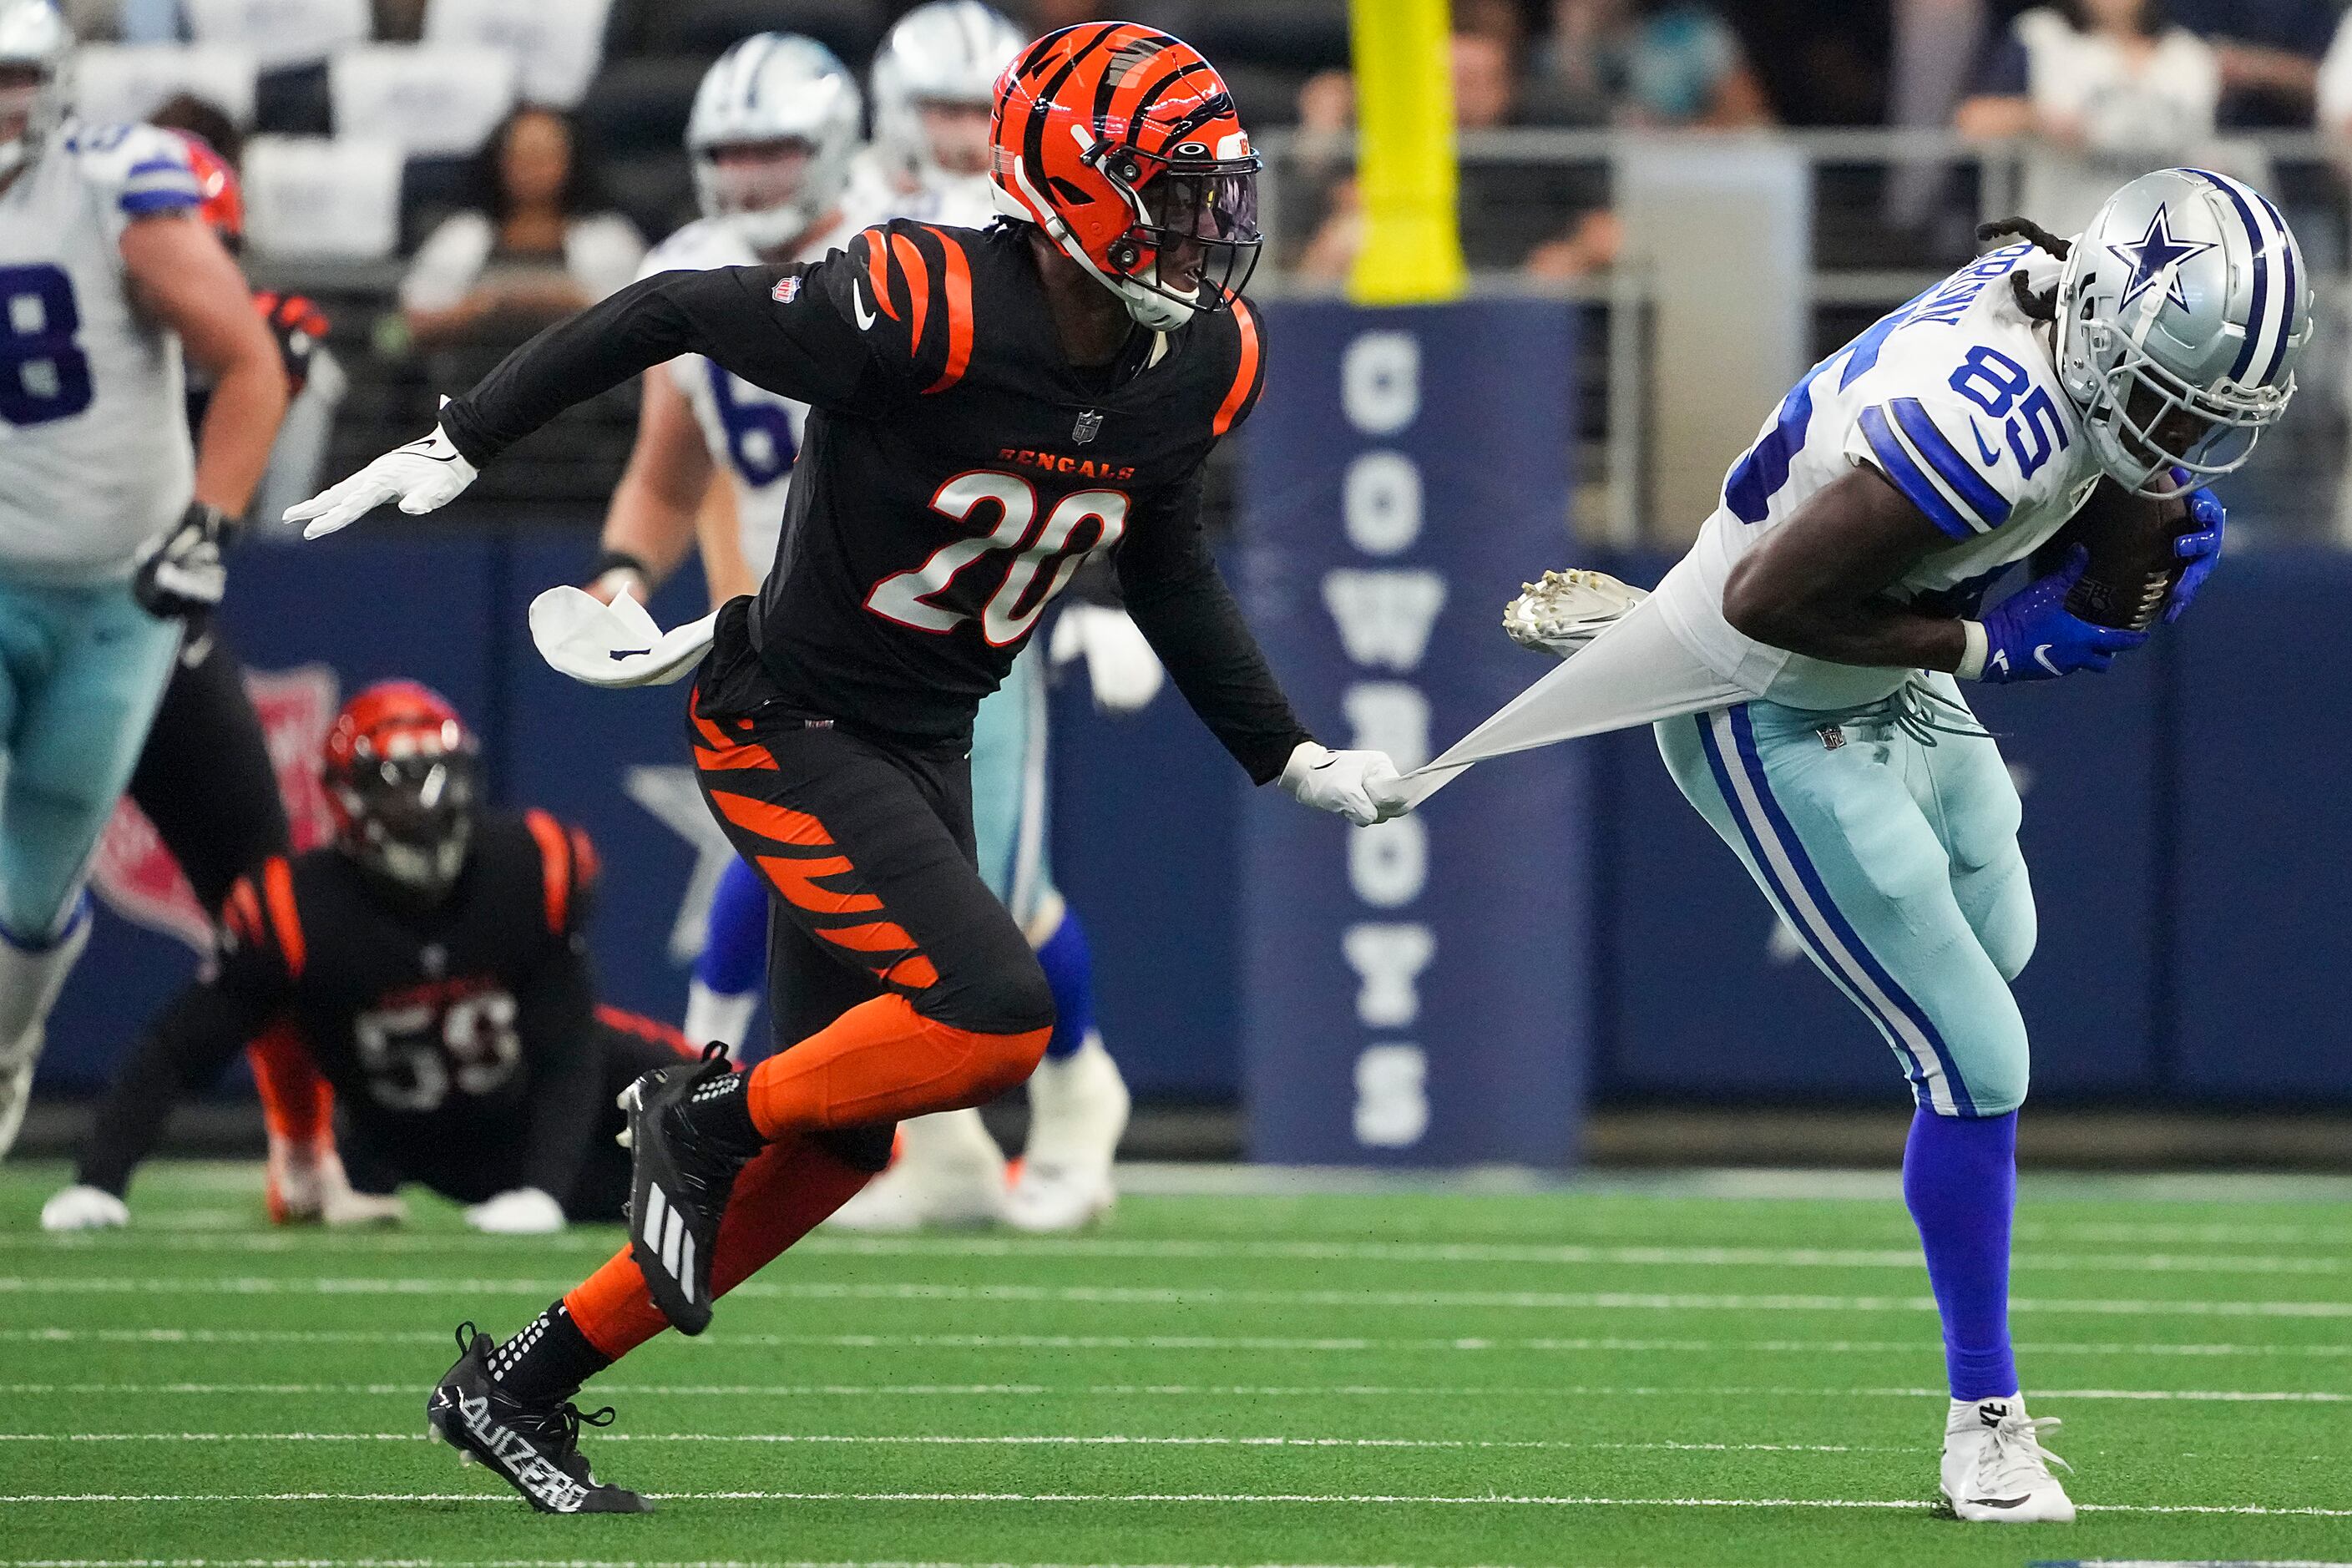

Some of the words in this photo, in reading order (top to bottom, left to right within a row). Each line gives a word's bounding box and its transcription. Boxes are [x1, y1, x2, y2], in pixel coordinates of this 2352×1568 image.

[999, 448, 1136, 481] BENGALS
[1948, 346, 2070, 481] 85
[862, 468, 1131, 647] 20
[1323, 329, 1449, 1148] COWBOYS
